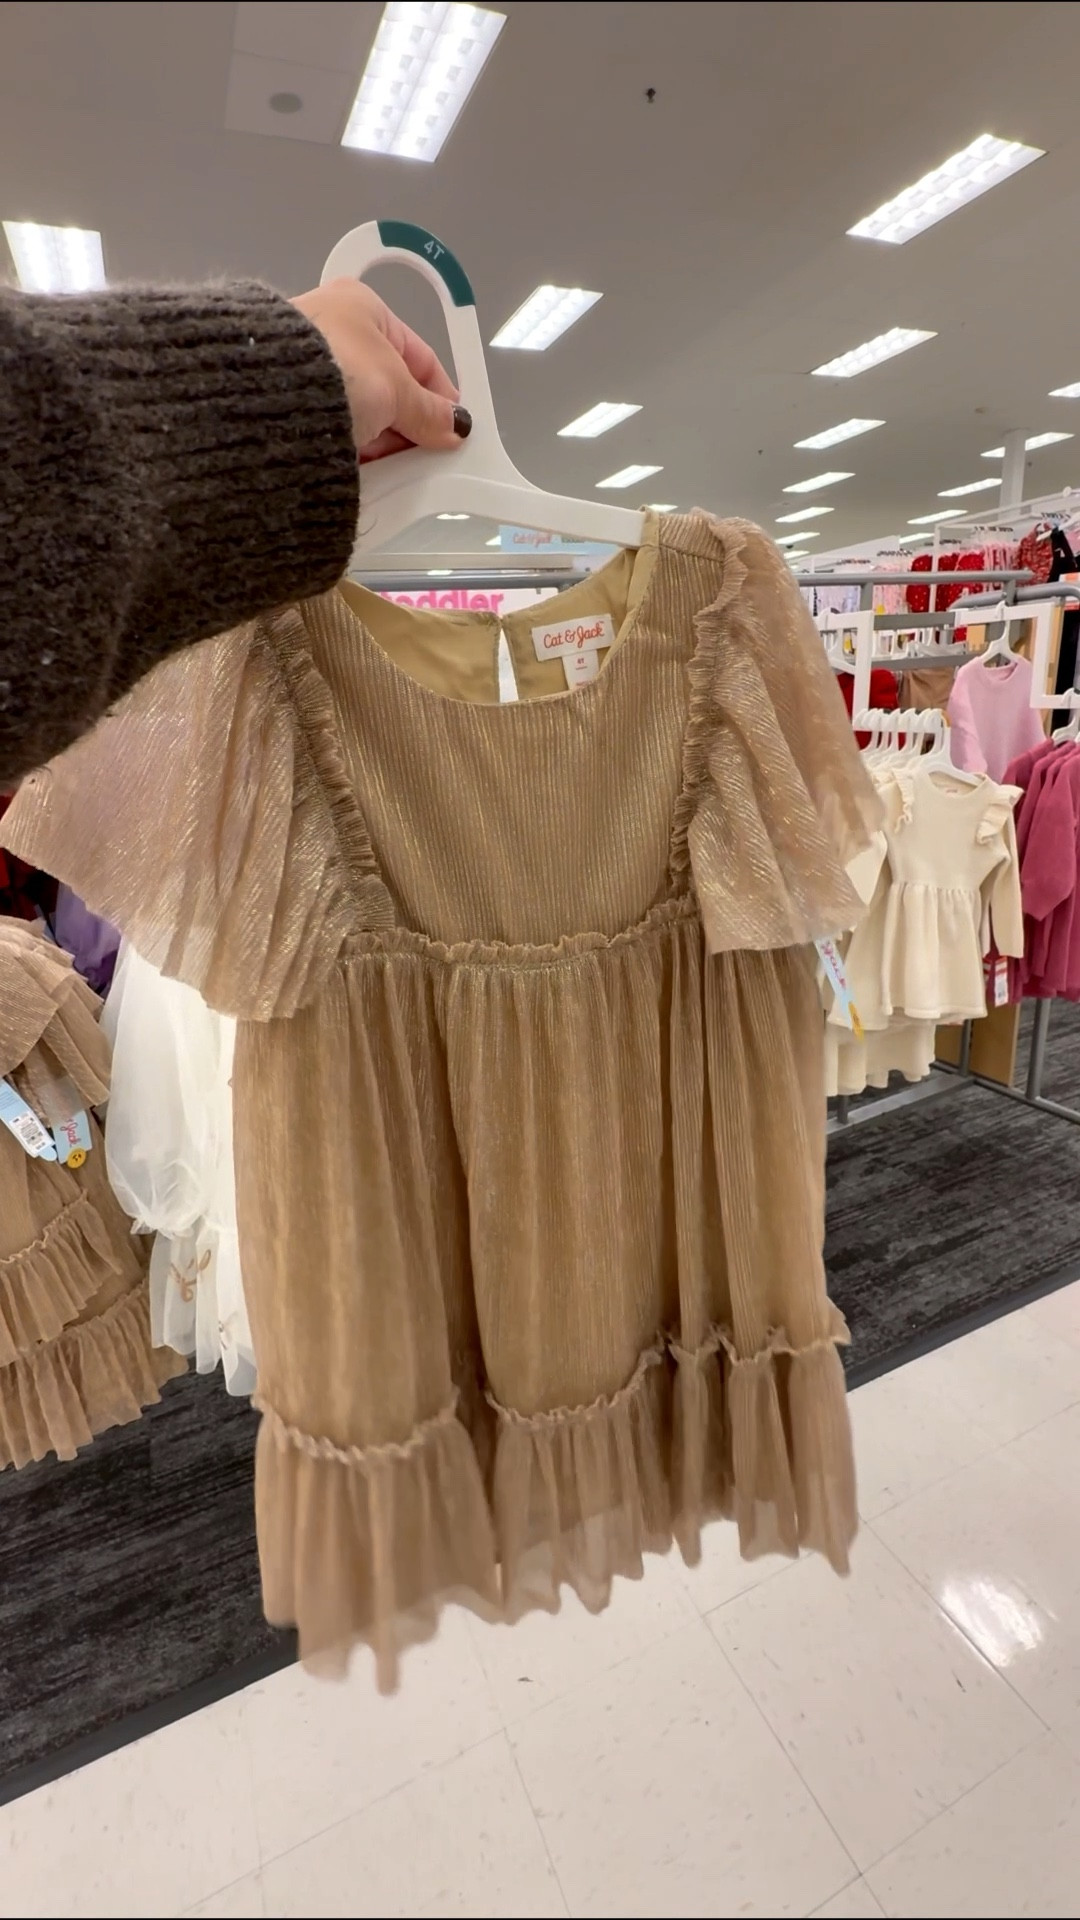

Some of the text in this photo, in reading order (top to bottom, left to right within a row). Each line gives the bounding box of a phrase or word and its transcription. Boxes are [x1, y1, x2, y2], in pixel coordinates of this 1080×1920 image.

[424, 241, 444, 260] 4T
[543, 622, 605, 648] Cat & Jack
